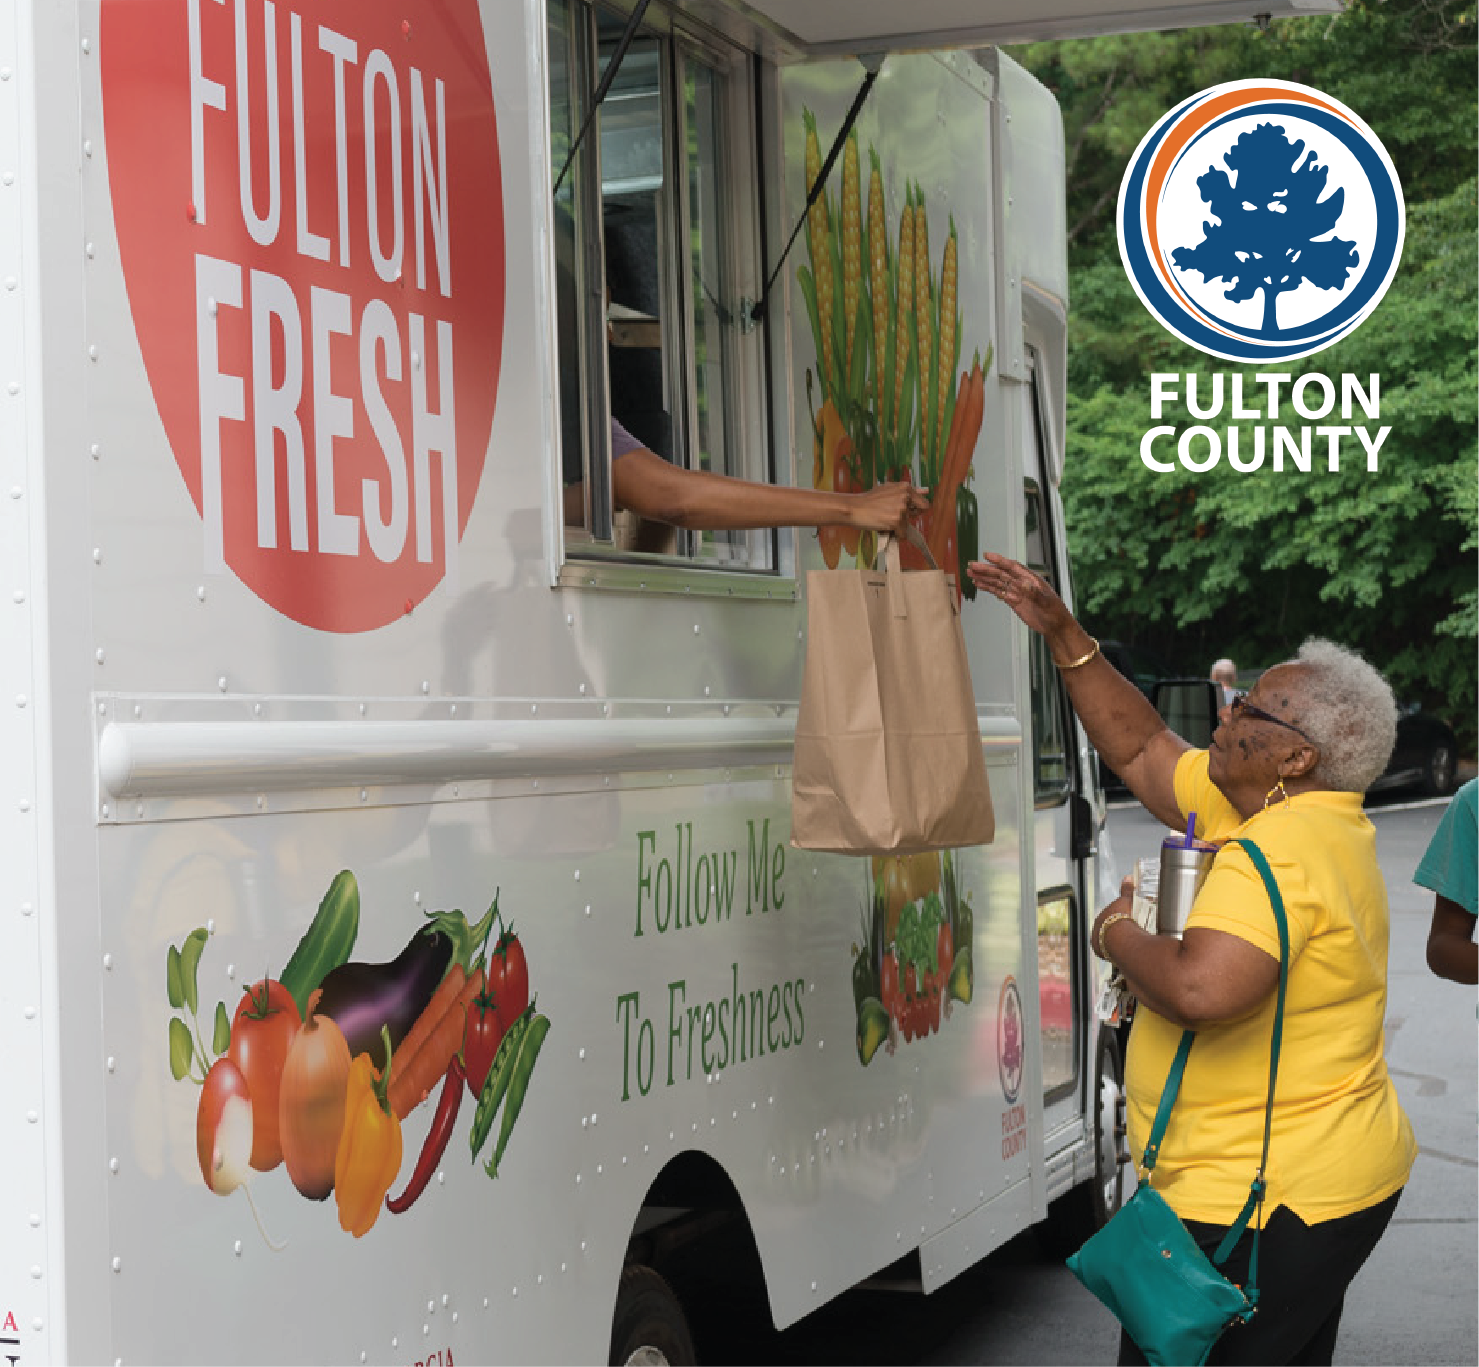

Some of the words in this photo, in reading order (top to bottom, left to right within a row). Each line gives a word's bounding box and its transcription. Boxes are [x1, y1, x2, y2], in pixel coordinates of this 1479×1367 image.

[186, 0, 452, 299] FULTON
[195, 253, 459, 600] FRESH
[634, 822, 737, 937] Follow
[746, 818, 786, 917] Me
[616, 990, 654, 1102] To
[667, 962, 805, 1086] Freshness
[1001, 1104, 1027, 1136] FULTON
[1001, 1128, 1027, 1162] COUNTY
